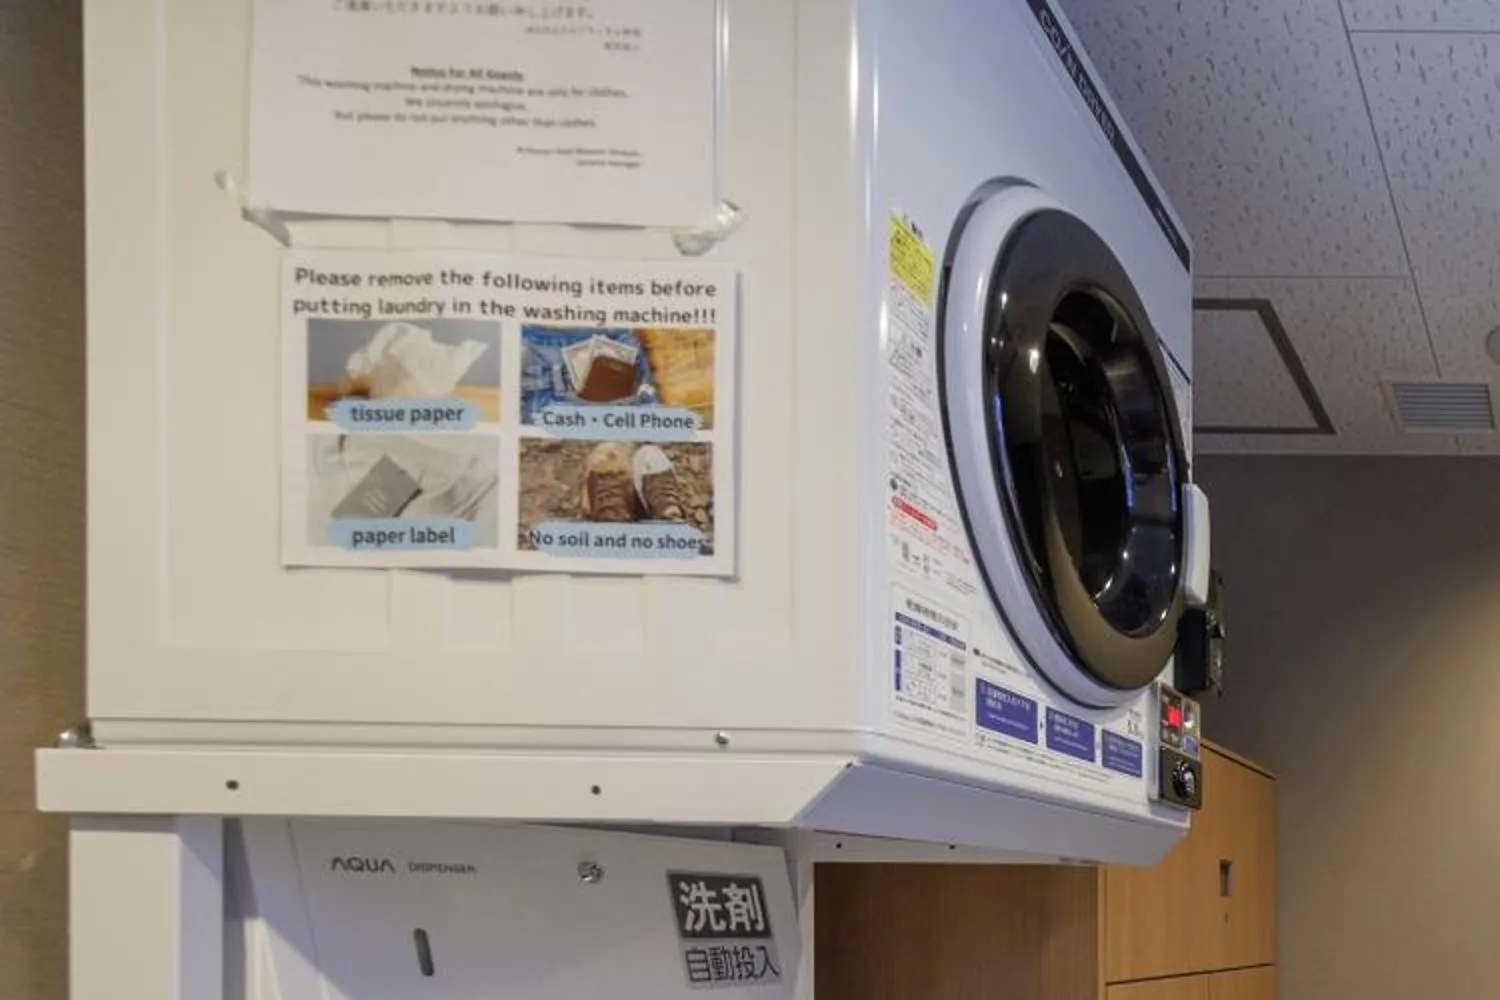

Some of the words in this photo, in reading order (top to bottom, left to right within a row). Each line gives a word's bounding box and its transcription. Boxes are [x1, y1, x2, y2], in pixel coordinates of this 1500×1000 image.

[295, 267, 362, 287] Please
[367, 271, 434, 287] remove
[440, 269, 474, 286] the
[483, 271, 583, 298] following
[590, 277, 644, 296] items
[651, 279, 717, 298] before
[293, 297, 372, 319] putting
[378, 297, 447, 315] laundry
[452, 297, 471, 313] in
[480, 298, 516, 317] the
[524, 304, 608, 325] washing
[613, 307, 717, 325] machine!!!
[350, 404, 406, 423] tissue
[410, 406, 465, 425] paper
[542, 411, 586, 428] Cash
[603, 413, 635, 429] Cell
[640, 413, 694, 430] Phone
[352, 530, 406, 547] paper
[410, 527, 456, 545] label
[528, 530, 553, 546] No
[559, 530, 590, 548] soil
[594, 531, 627, 550] and
[631, 537, 653, 550] no
[330, 856, 397, 874] AQUA
[679, 881, 765, 932] 洗剤
[685, 944, 780, 983] 自動投入
